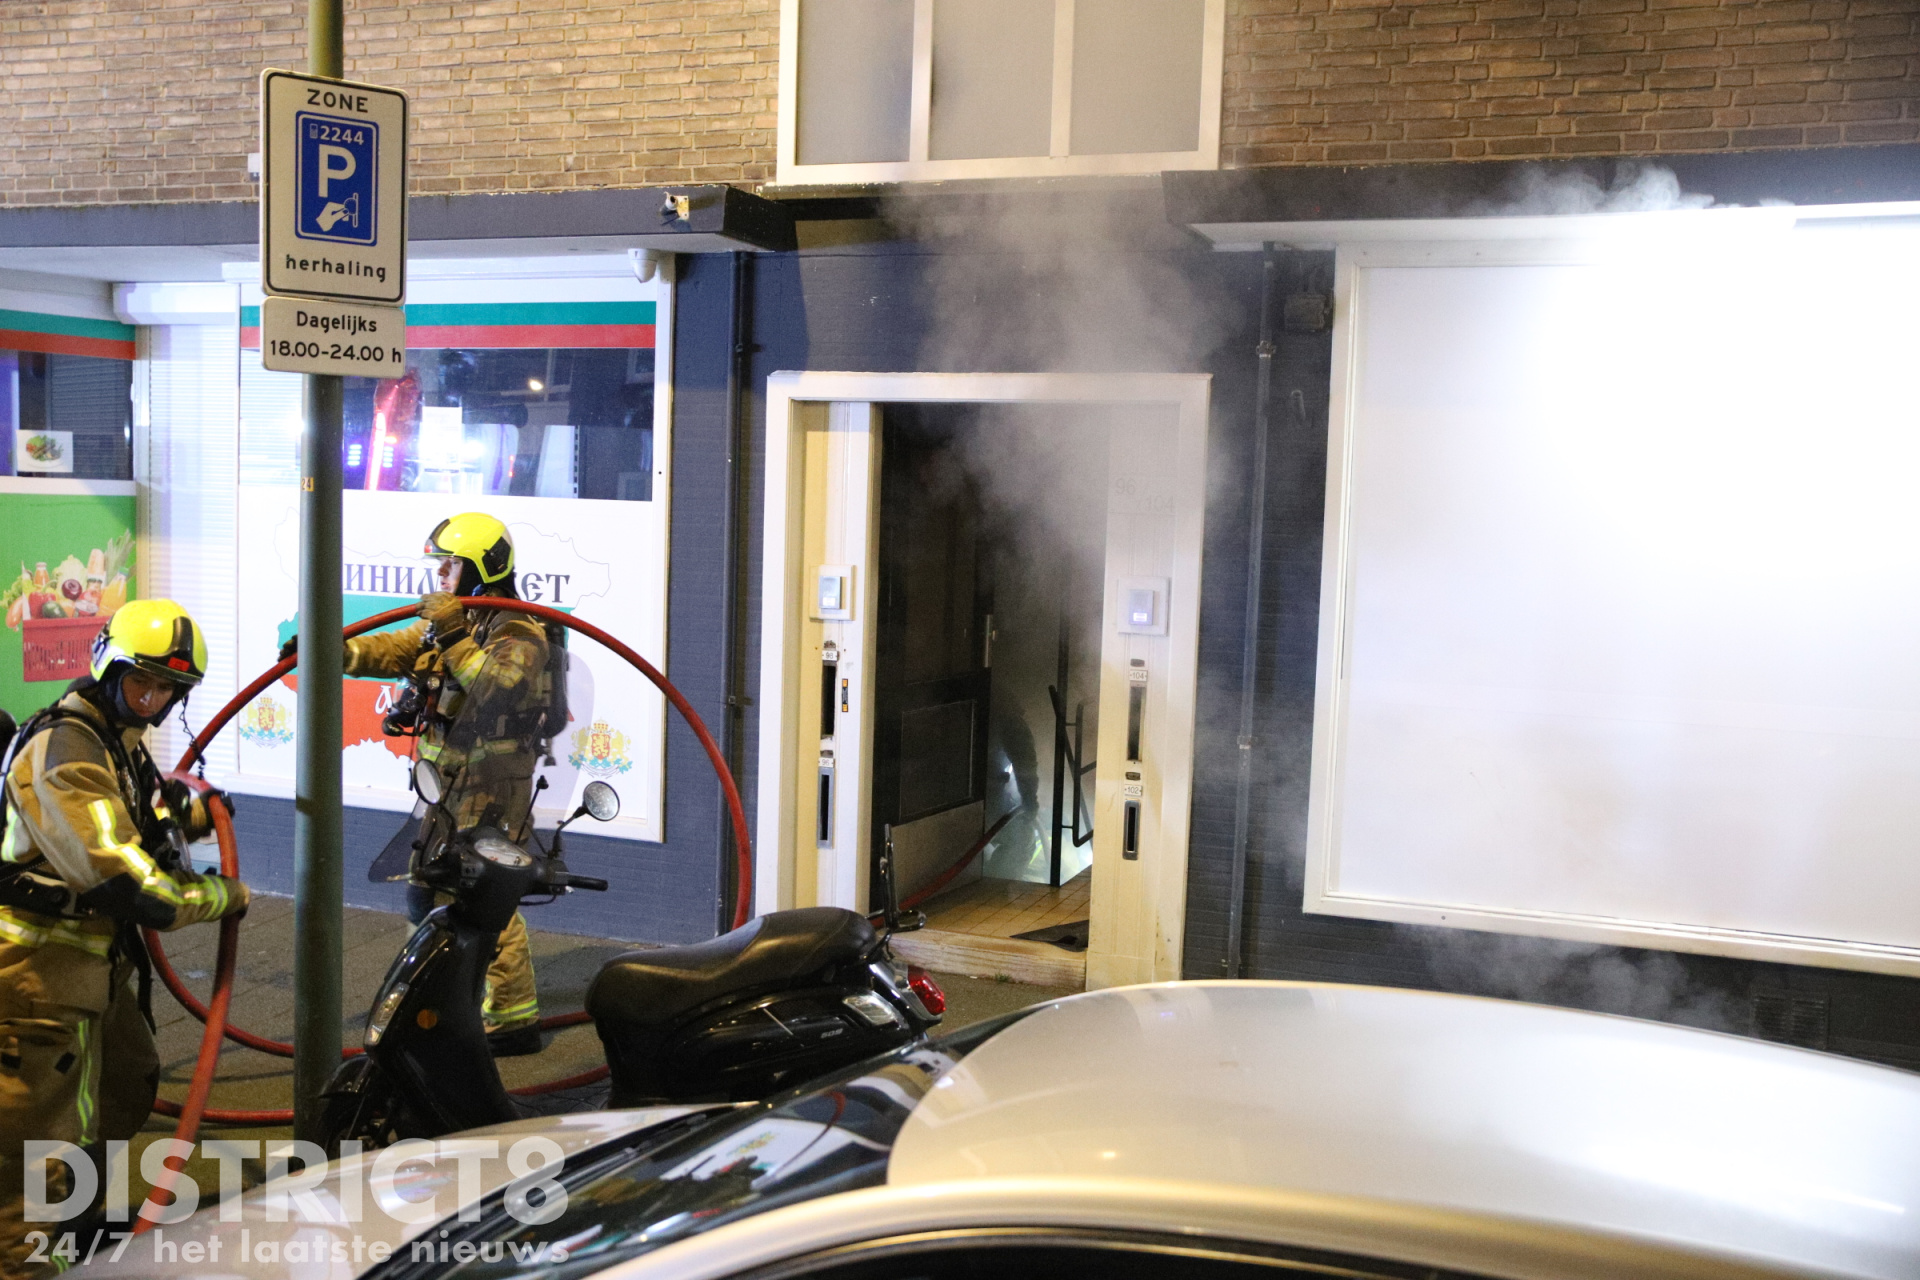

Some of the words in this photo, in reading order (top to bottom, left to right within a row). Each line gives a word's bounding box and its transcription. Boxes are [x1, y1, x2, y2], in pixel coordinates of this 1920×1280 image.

[307, 88, 368, 113] ZONE
[320, 125, 365, 145] 2244
[318, 144, 357, 198] P
[286, 254, 386, 282] herhaling
[296, 311, 377, 336] Dagelijks
[270, 340, 384, 362] 18.00-24.00
[392, 347, 402, 363] h
[1127, 786, 1140, 794] 102
